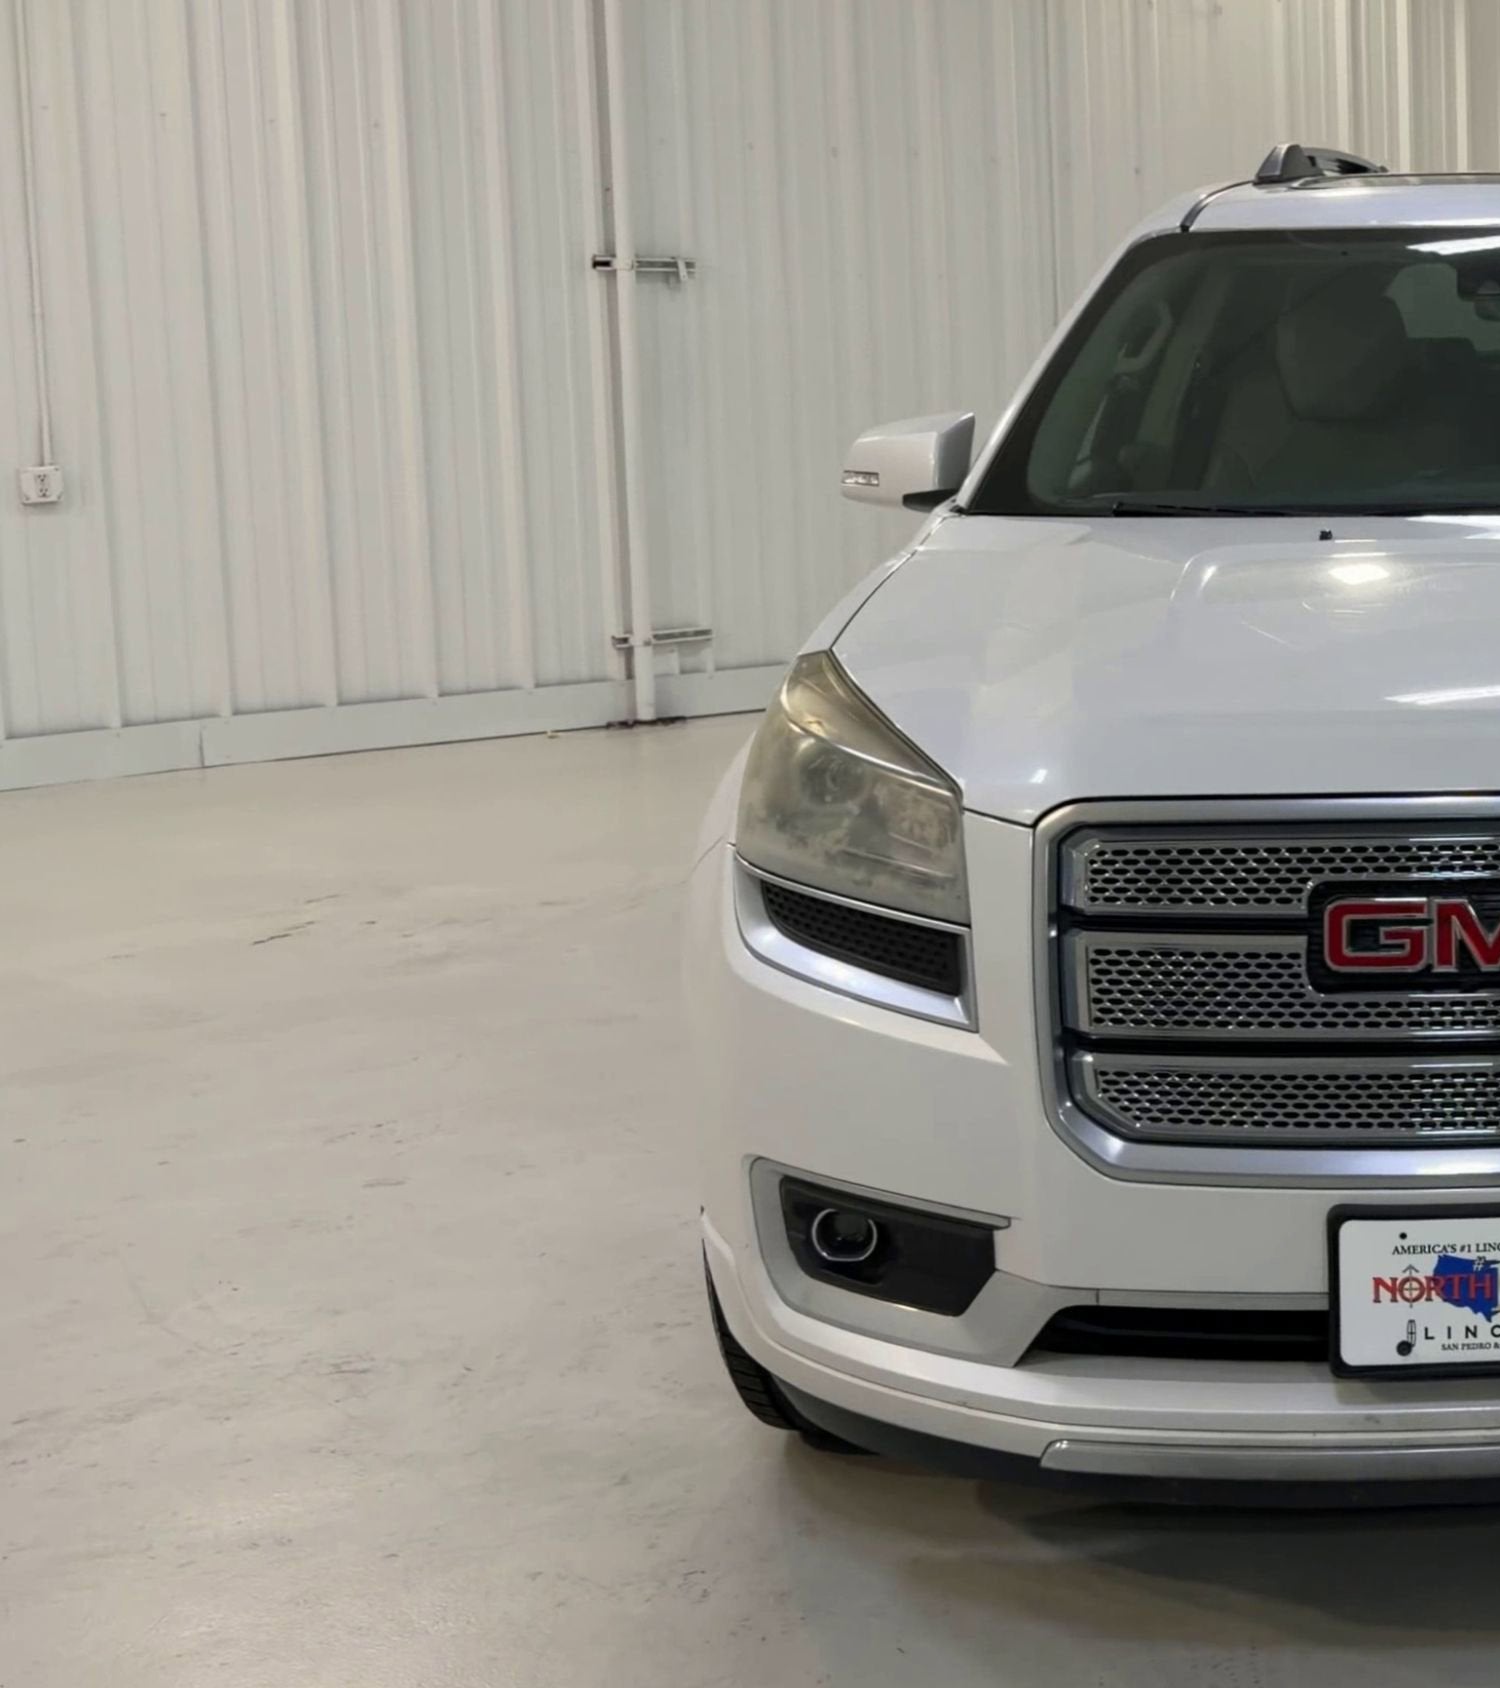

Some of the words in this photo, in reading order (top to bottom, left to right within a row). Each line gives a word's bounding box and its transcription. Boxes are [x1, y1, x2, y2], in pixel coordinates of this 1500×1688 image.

[1392, 1243, 1457, 1256] AMERICA'S
[1459, 1243, 1472, 1253] #1
[1372, 1272, 1493, 1304] NORTH
[1441, 1343, 1459, 1351] SAN
[1461, 1341, 1492, 1351] PEDRO
[1493, 1341, 1500, 1350] &
